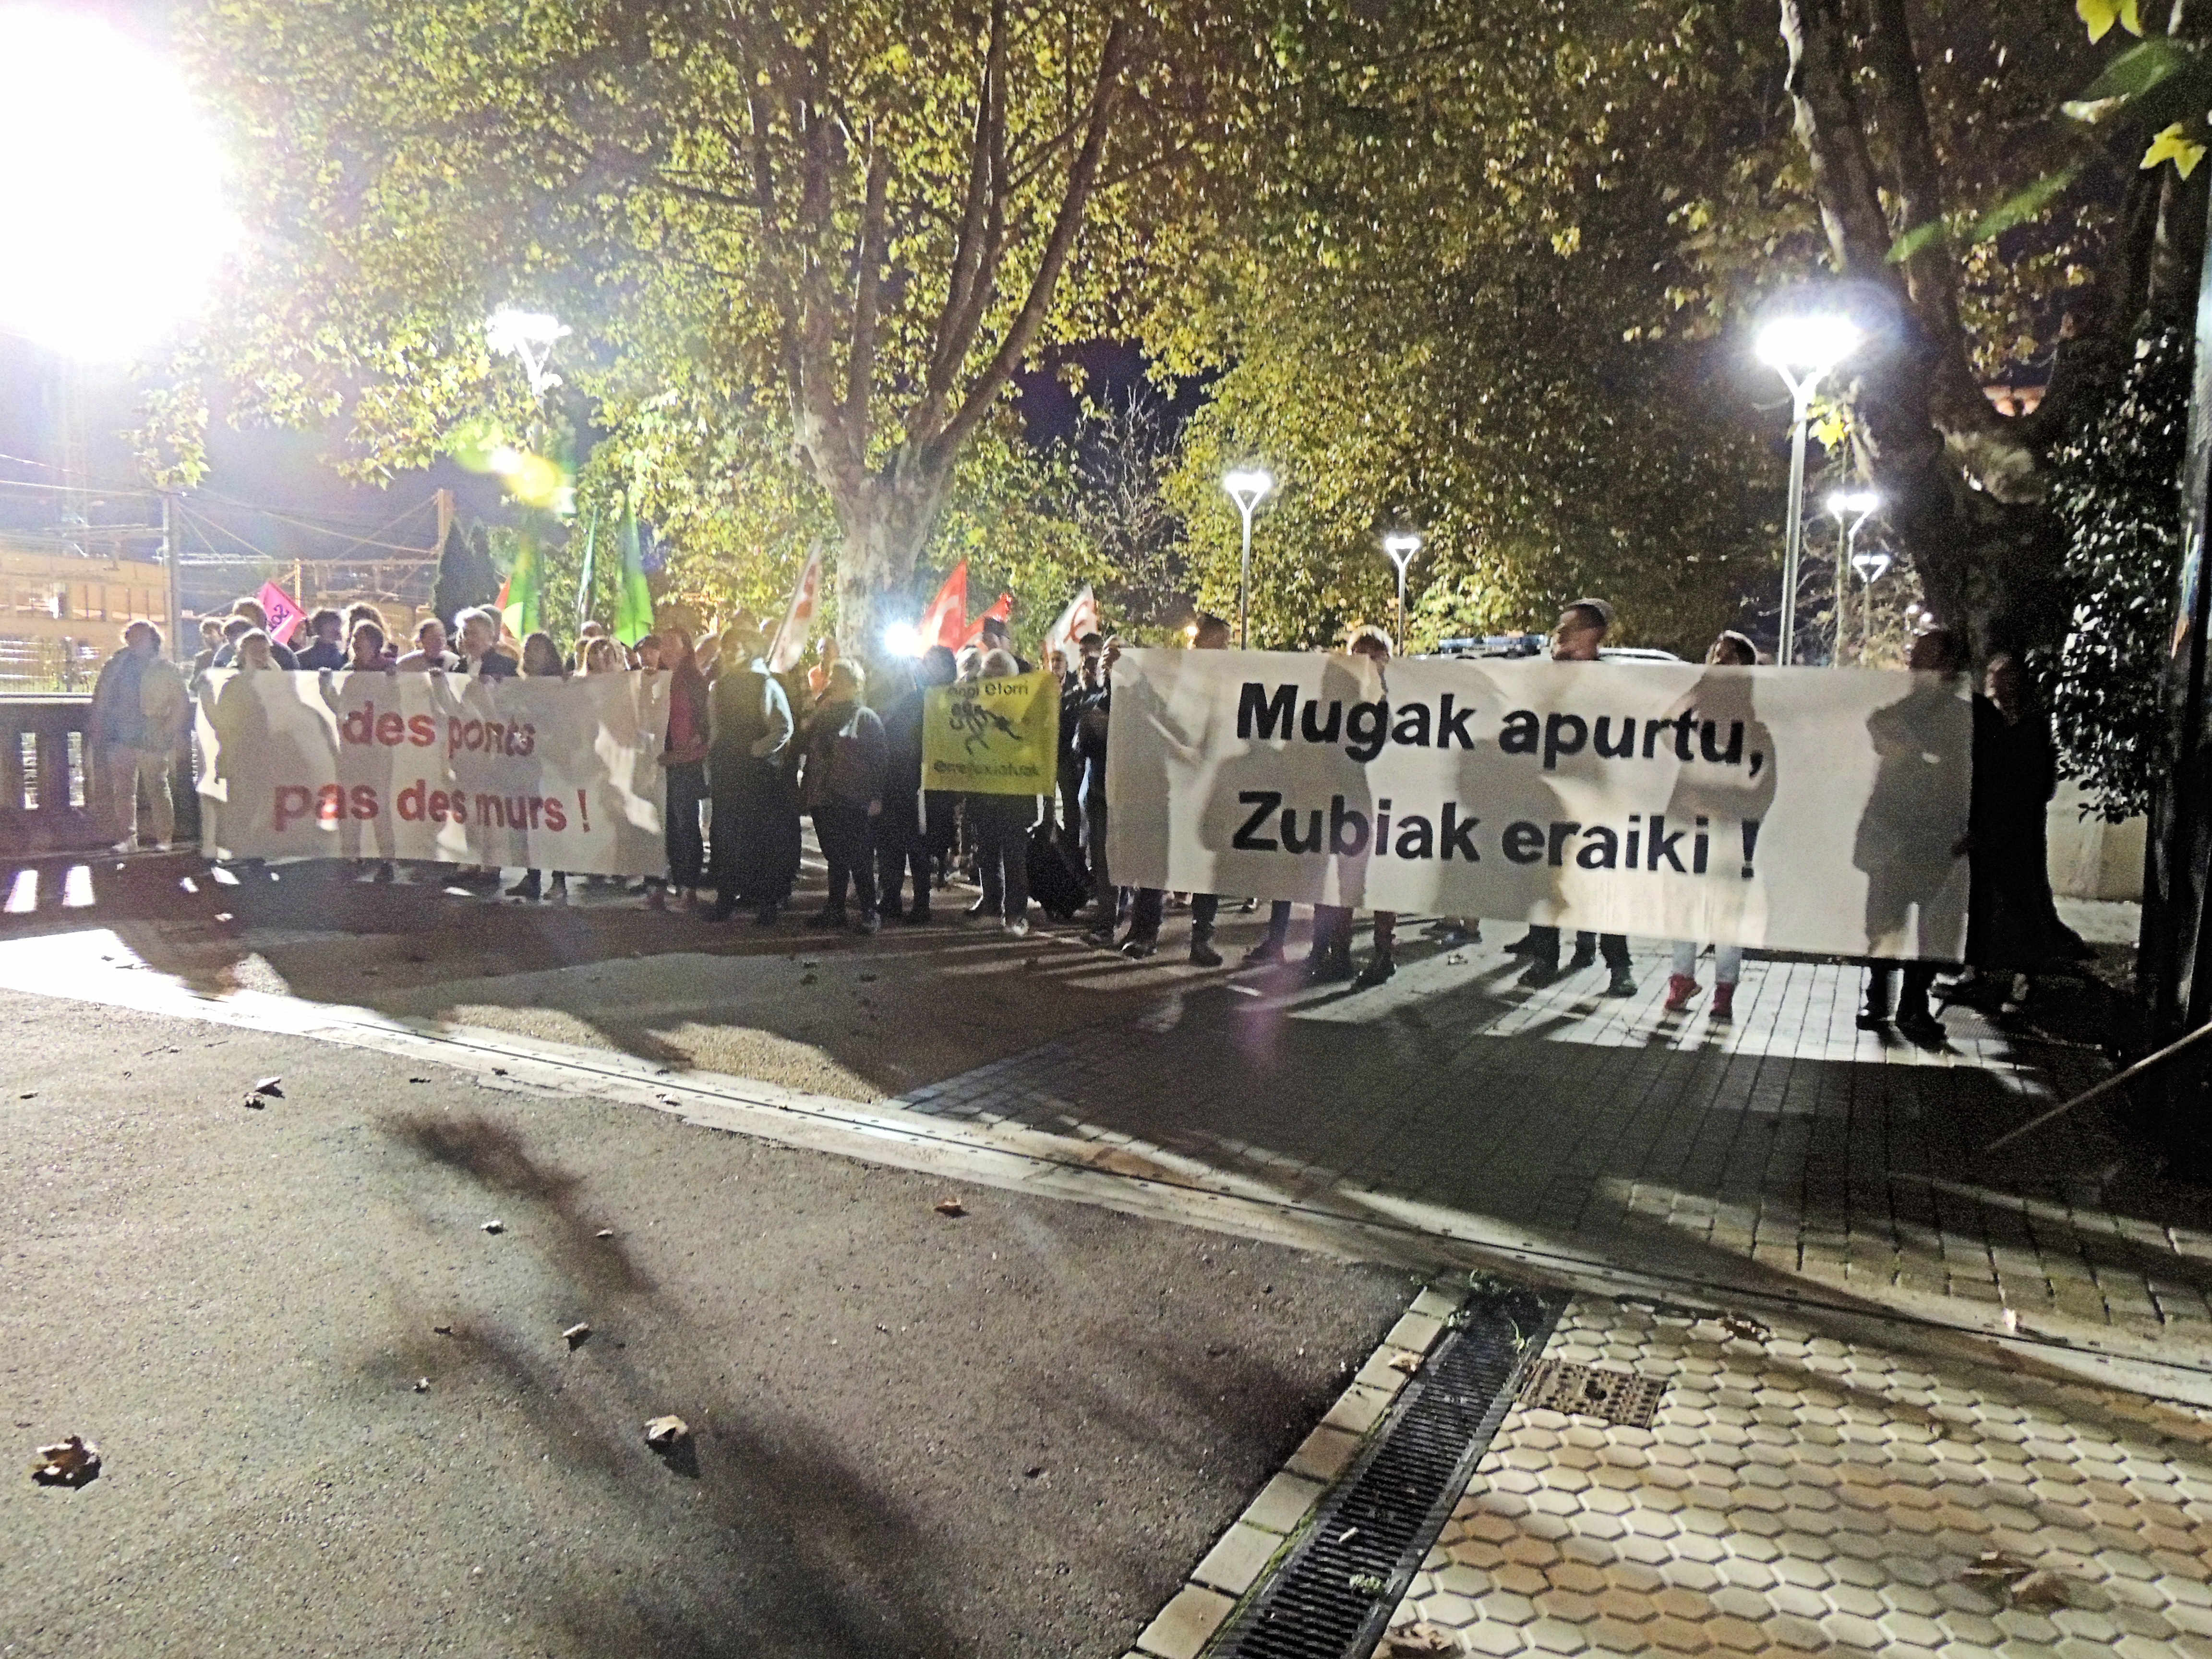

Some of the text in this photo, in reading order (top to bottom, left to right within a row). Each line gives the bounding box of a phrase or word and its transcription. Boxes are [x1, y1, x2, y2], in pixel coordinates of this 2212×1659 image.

[342, 701, 536, 758] des ponts
[1237, 683, 1766, 778] Mugak apurtu,
[274, 778, 590, 833] pas des murs !
[1231, 790, 1758, 879] Zubiak eraiki !
